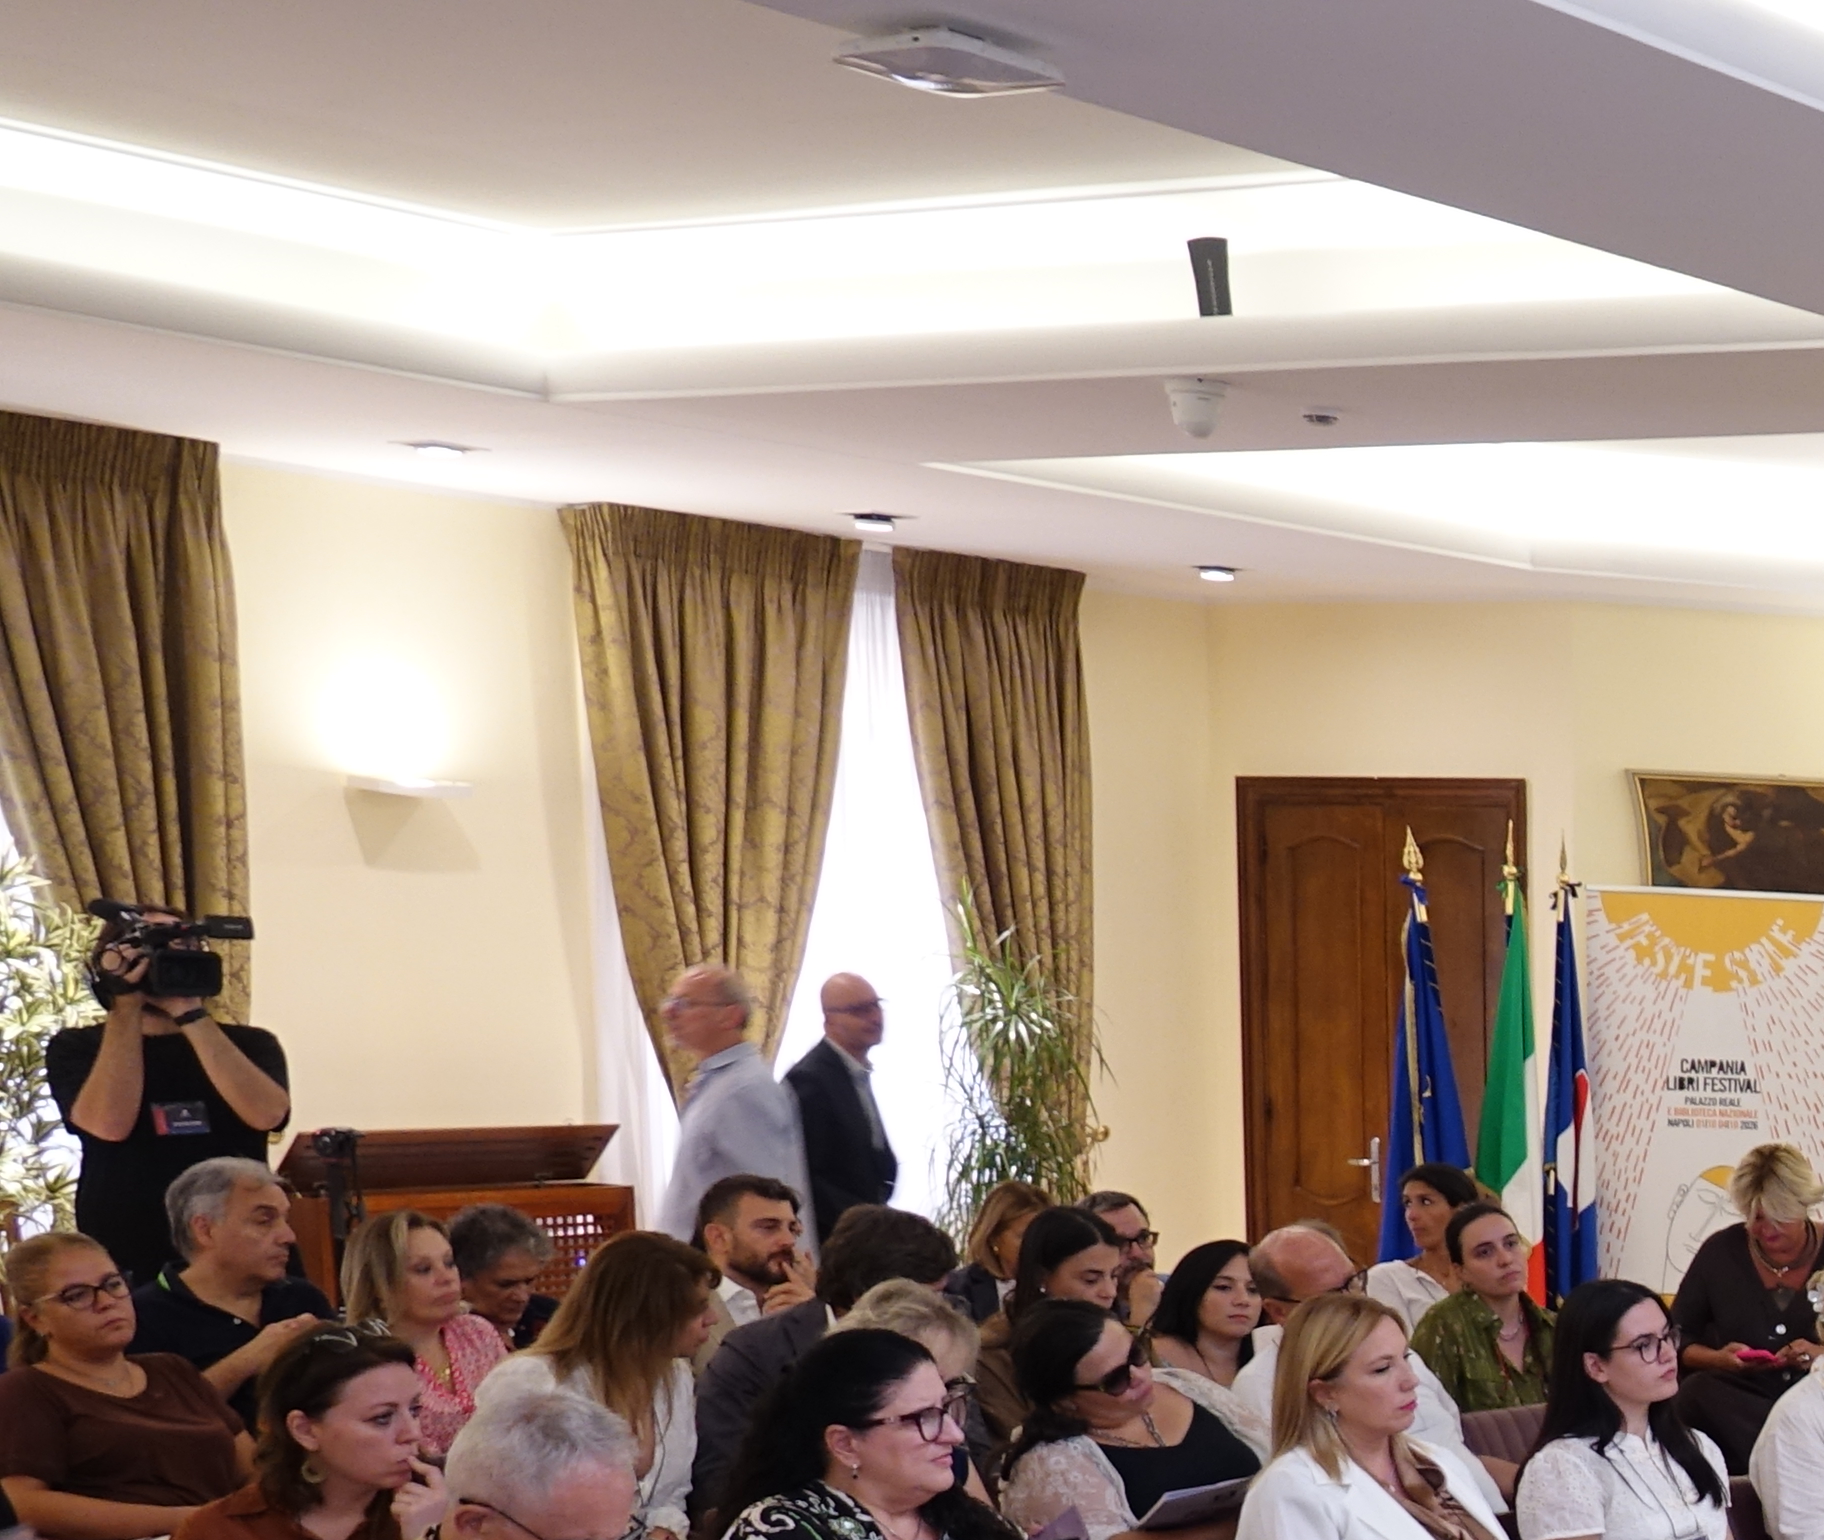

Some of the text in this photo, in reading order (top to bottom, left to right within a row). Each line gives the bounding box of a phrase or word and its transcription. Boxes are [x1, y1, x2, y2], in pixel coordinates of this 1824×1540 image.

[1680, 1058, 1747, 1075] CAMPANIA
[1666, 1075, 1761, 1093] LIBRI FESTIVAL
[1684, 1096, 1741, 1107] PALAZZO REALE
[1667, 1118, 1694, 1128] NAPOLI
